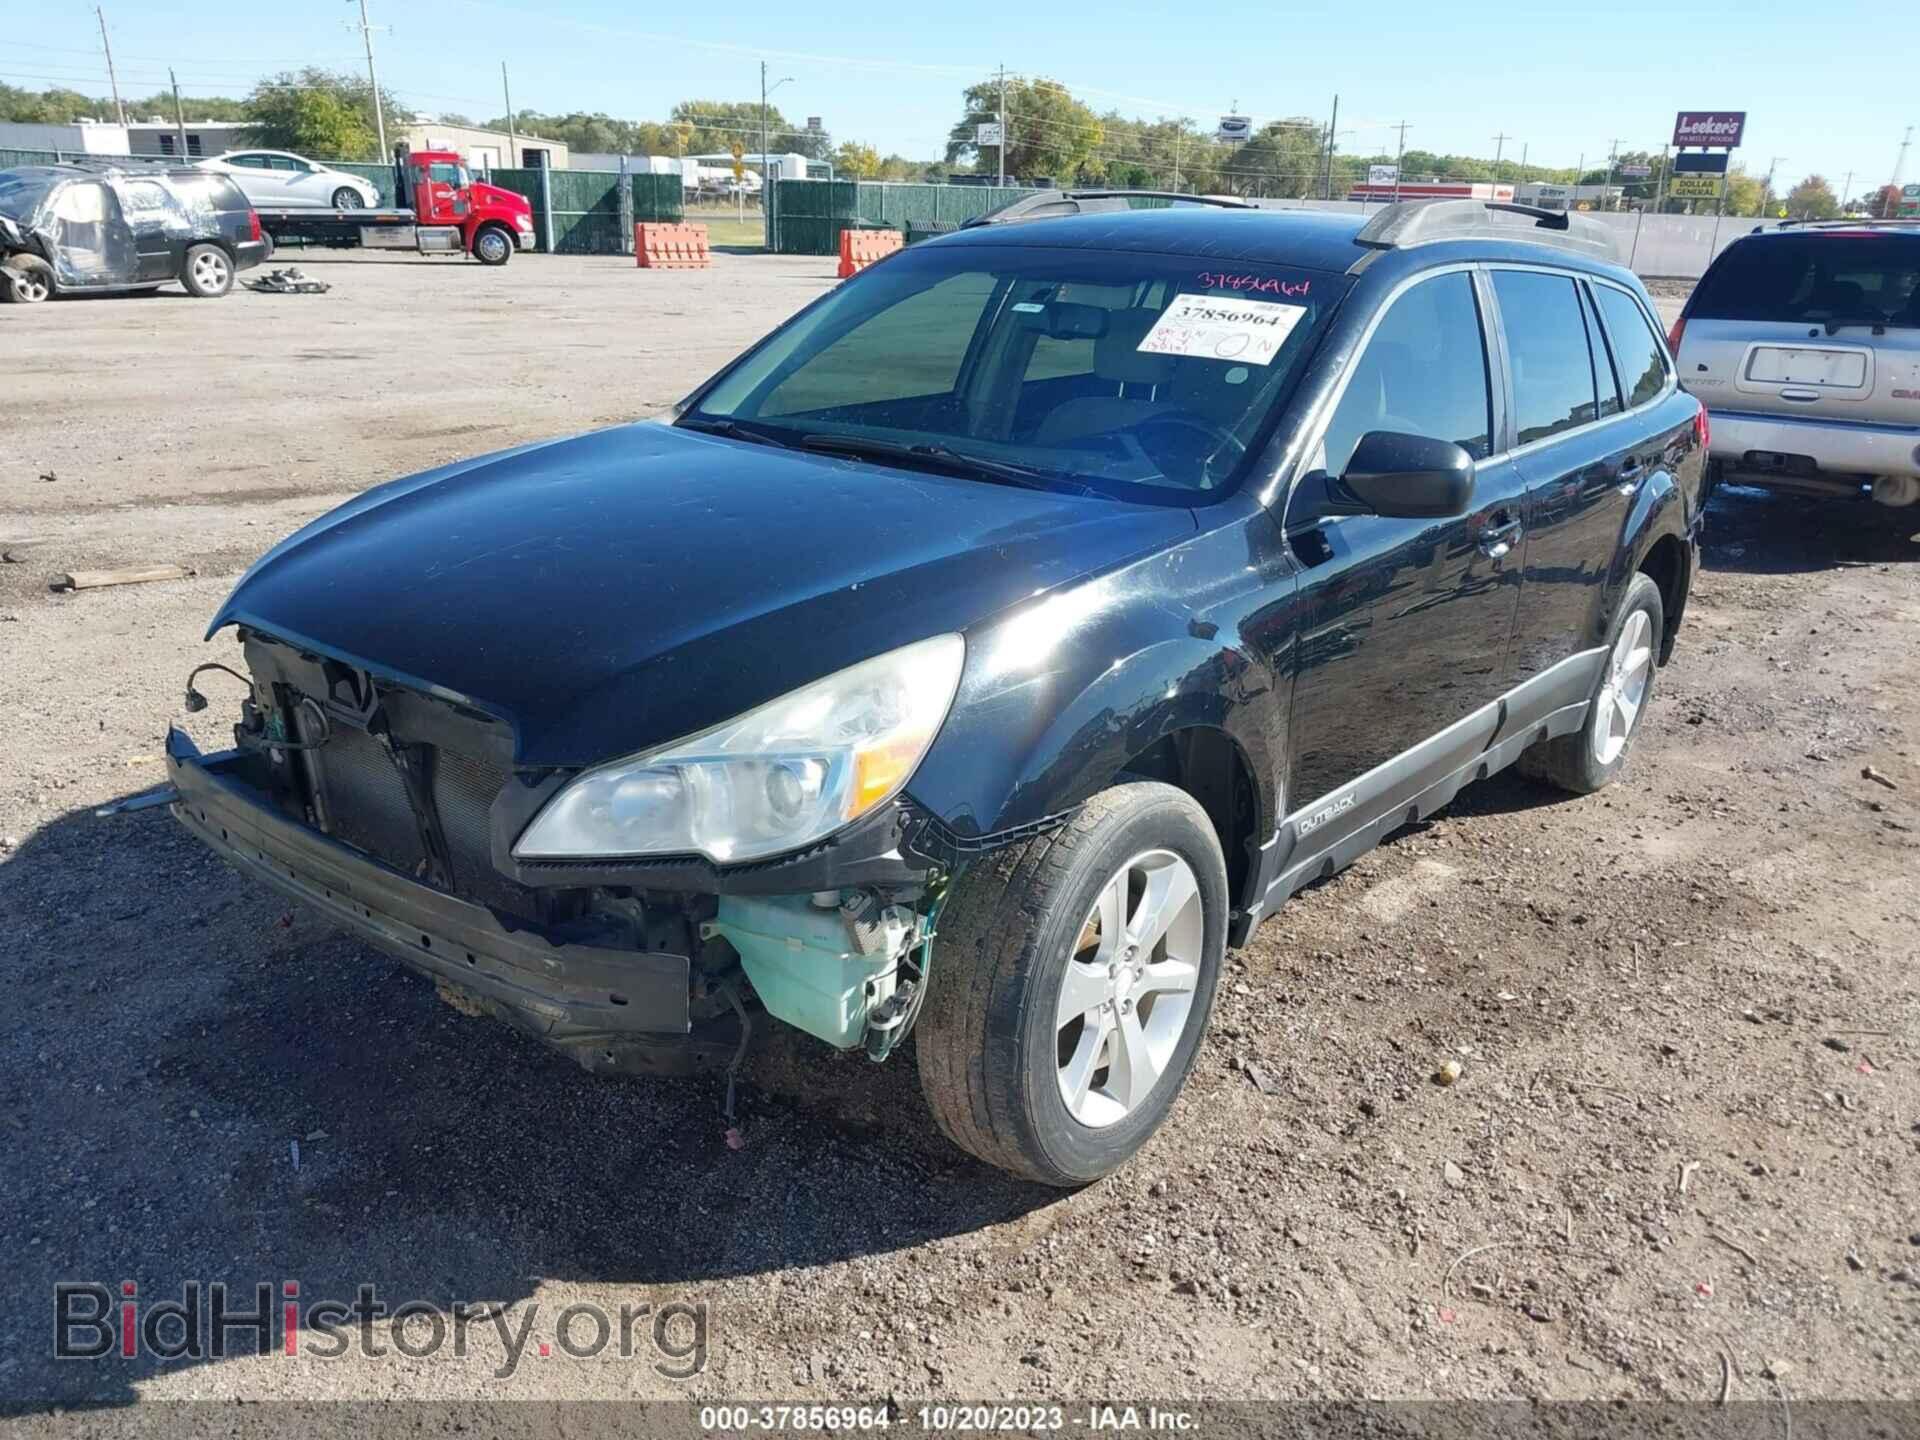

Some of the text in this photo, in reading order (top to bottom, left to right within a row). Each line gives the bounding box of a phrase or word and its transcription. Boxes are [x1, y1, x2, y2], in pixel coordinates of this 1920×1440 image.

[1678, 116, 1740, 134] Leeker's
[1675, 188, 1714, 196] GENERAL
[1679, 180, 1714, 188] DOLLAR
[1197, 271, 1311, 297] 37856964
[1175, 306, 1280, 327] 37856964
